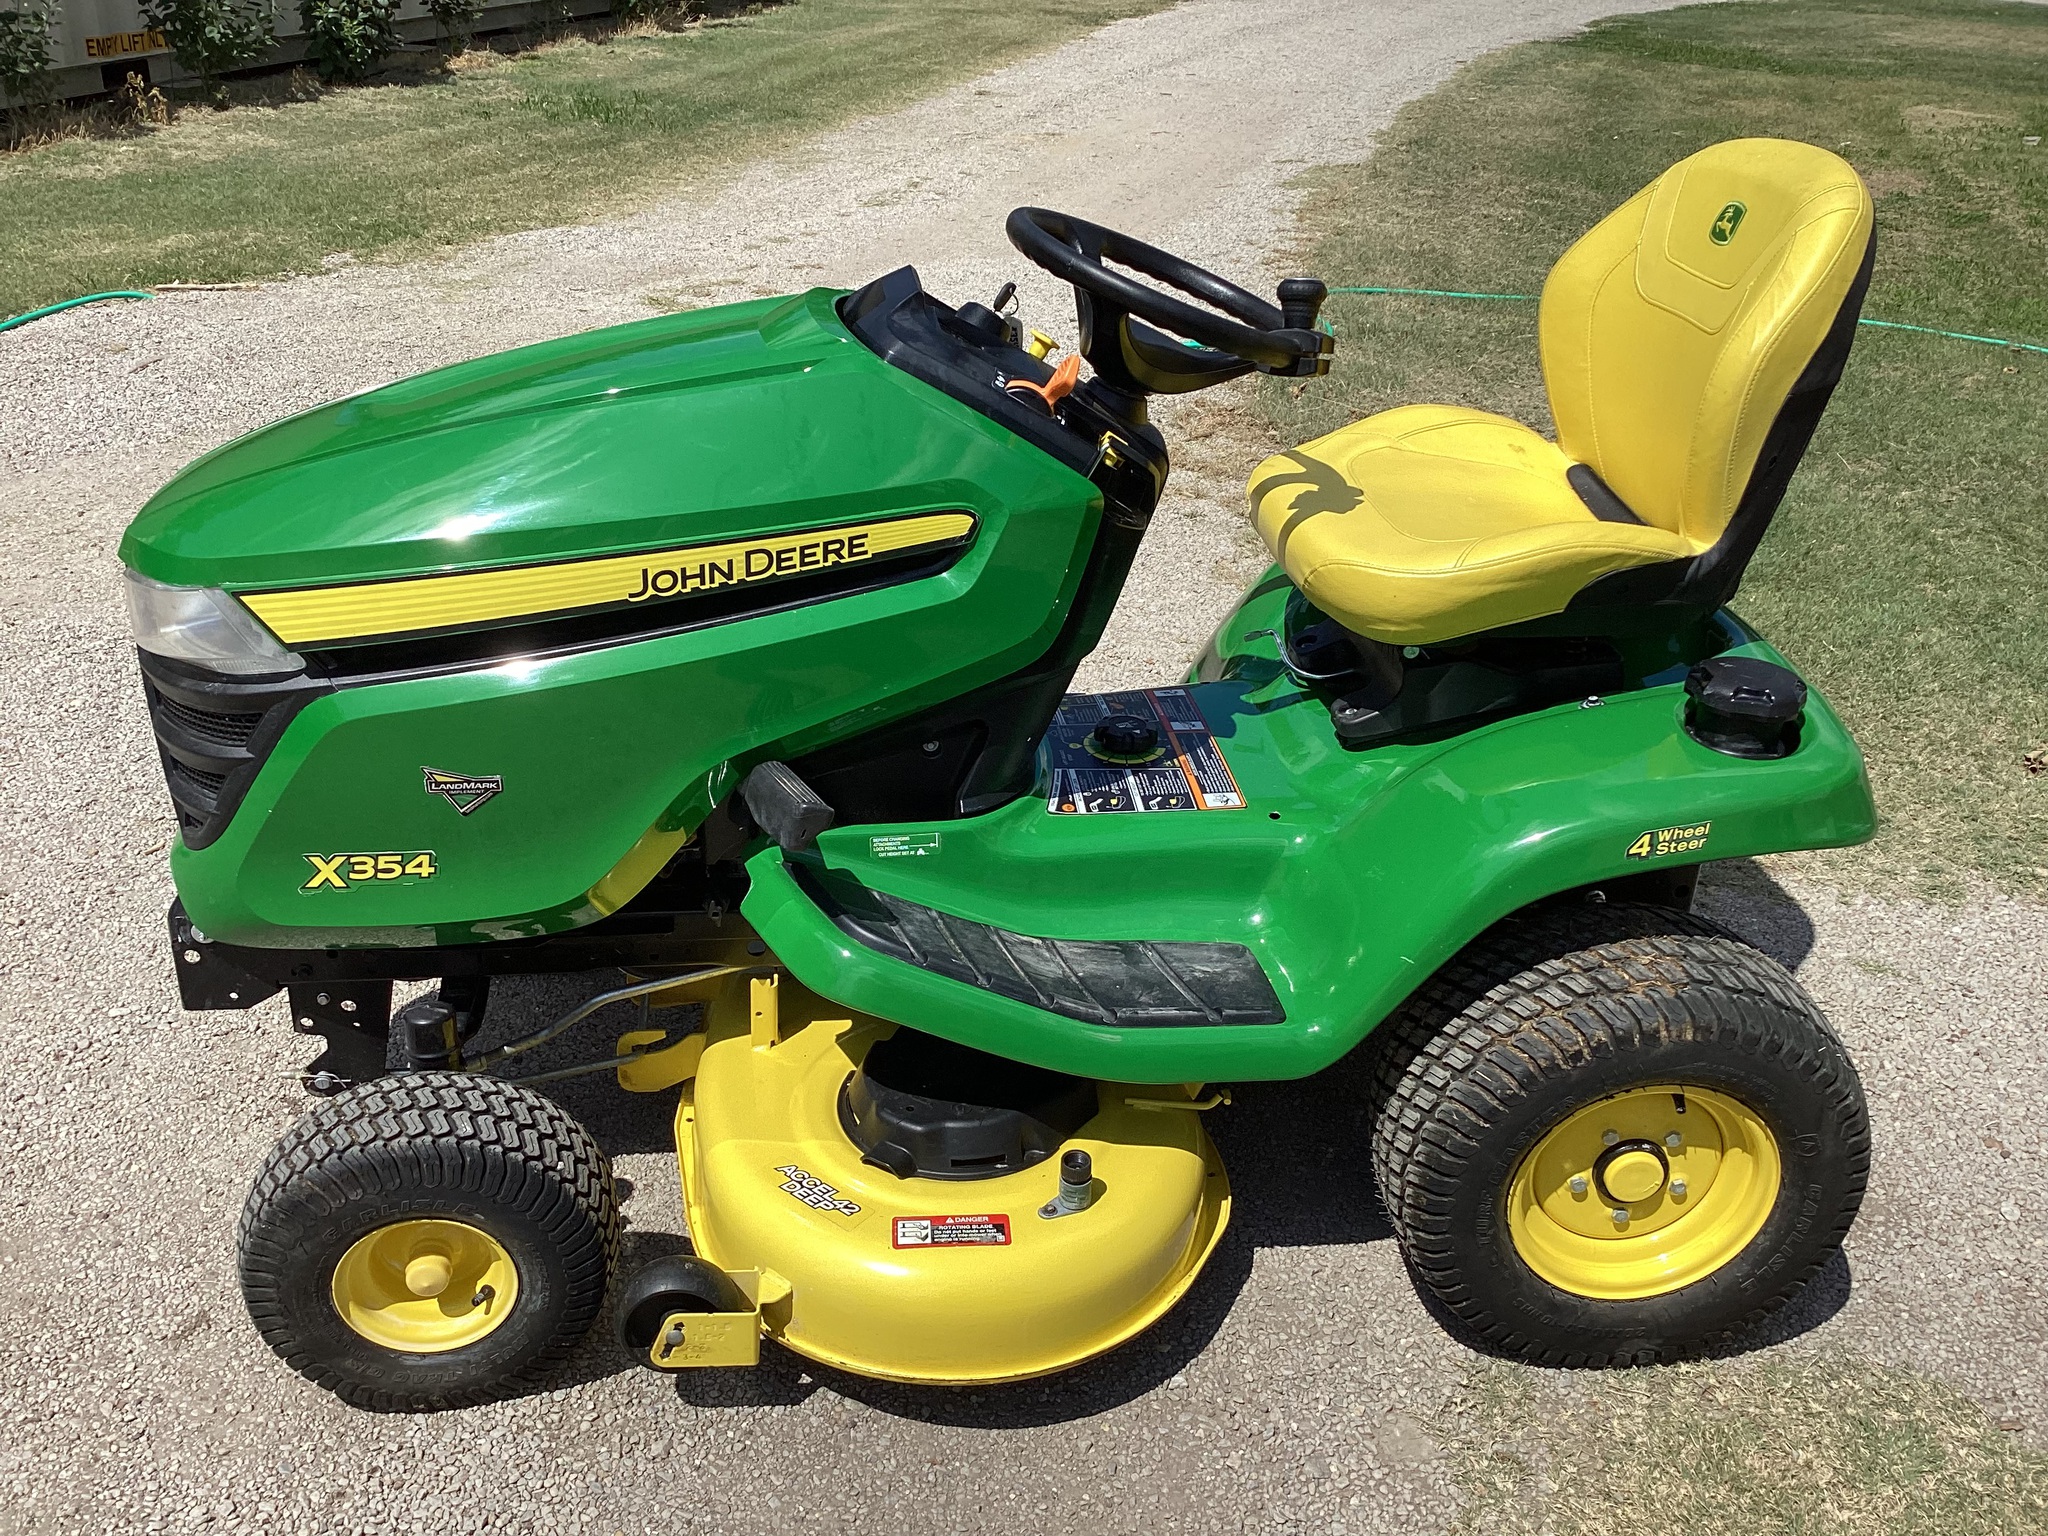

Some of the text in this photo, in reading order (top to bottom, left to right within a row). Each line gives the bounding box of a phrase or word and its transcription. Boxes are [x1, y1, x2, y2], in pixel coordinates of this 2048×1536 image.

[120, 33, 145, 52] LIFT
[628, 532, 870, 600] JOHN DEERE
[1628, 822, 1711, 857] 4 Wheel
[1655, 837, 1708, 855] Steer
[301, 854, 436, 888] X354
[774, 1164, 840, 1202] ACCEL
[778, 1180, 861, 1217] DEEP 42
